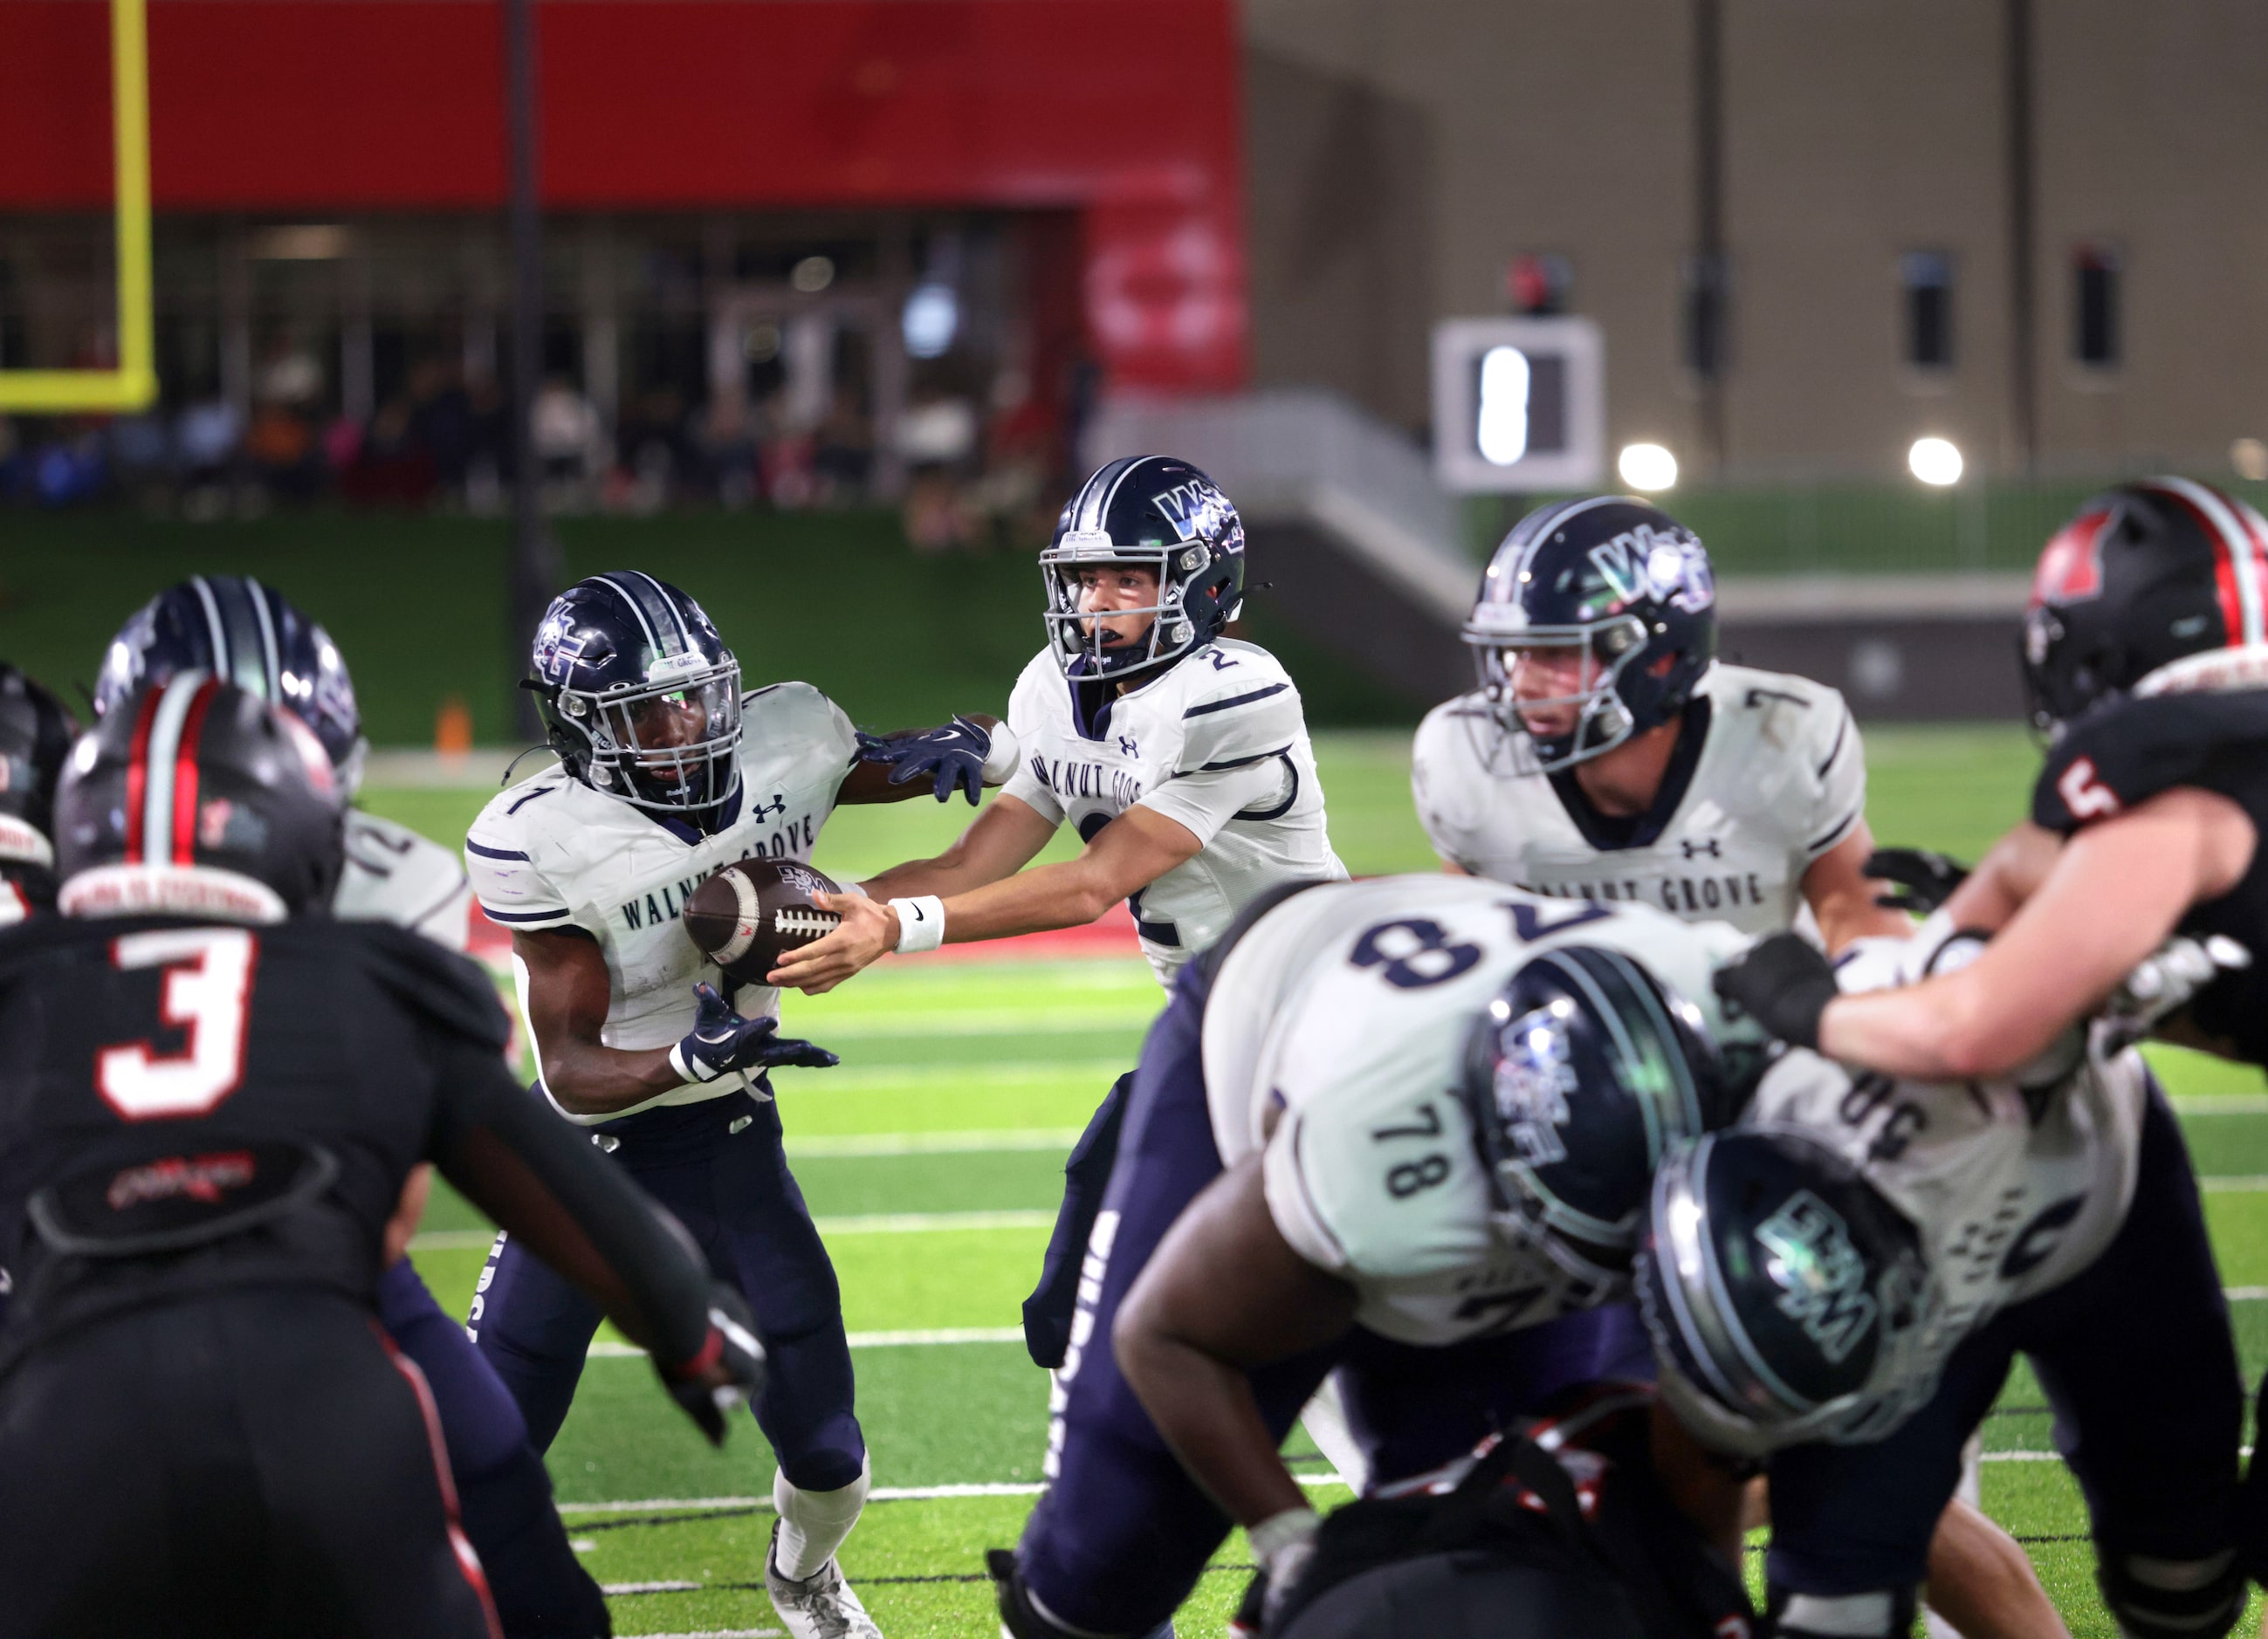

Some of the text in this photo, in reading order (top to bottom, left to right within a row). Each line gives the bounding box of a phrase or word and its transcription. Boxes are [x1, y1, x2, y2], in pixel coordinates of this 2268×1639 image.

[1199, 649, 1240, 671] 2
[506, 787, 556, 815] 1
[1660, 873, 1764, 912] GROVE
[94, 927, 260, 1122] 3
[1371, 1104, 1452, 1200] 78
